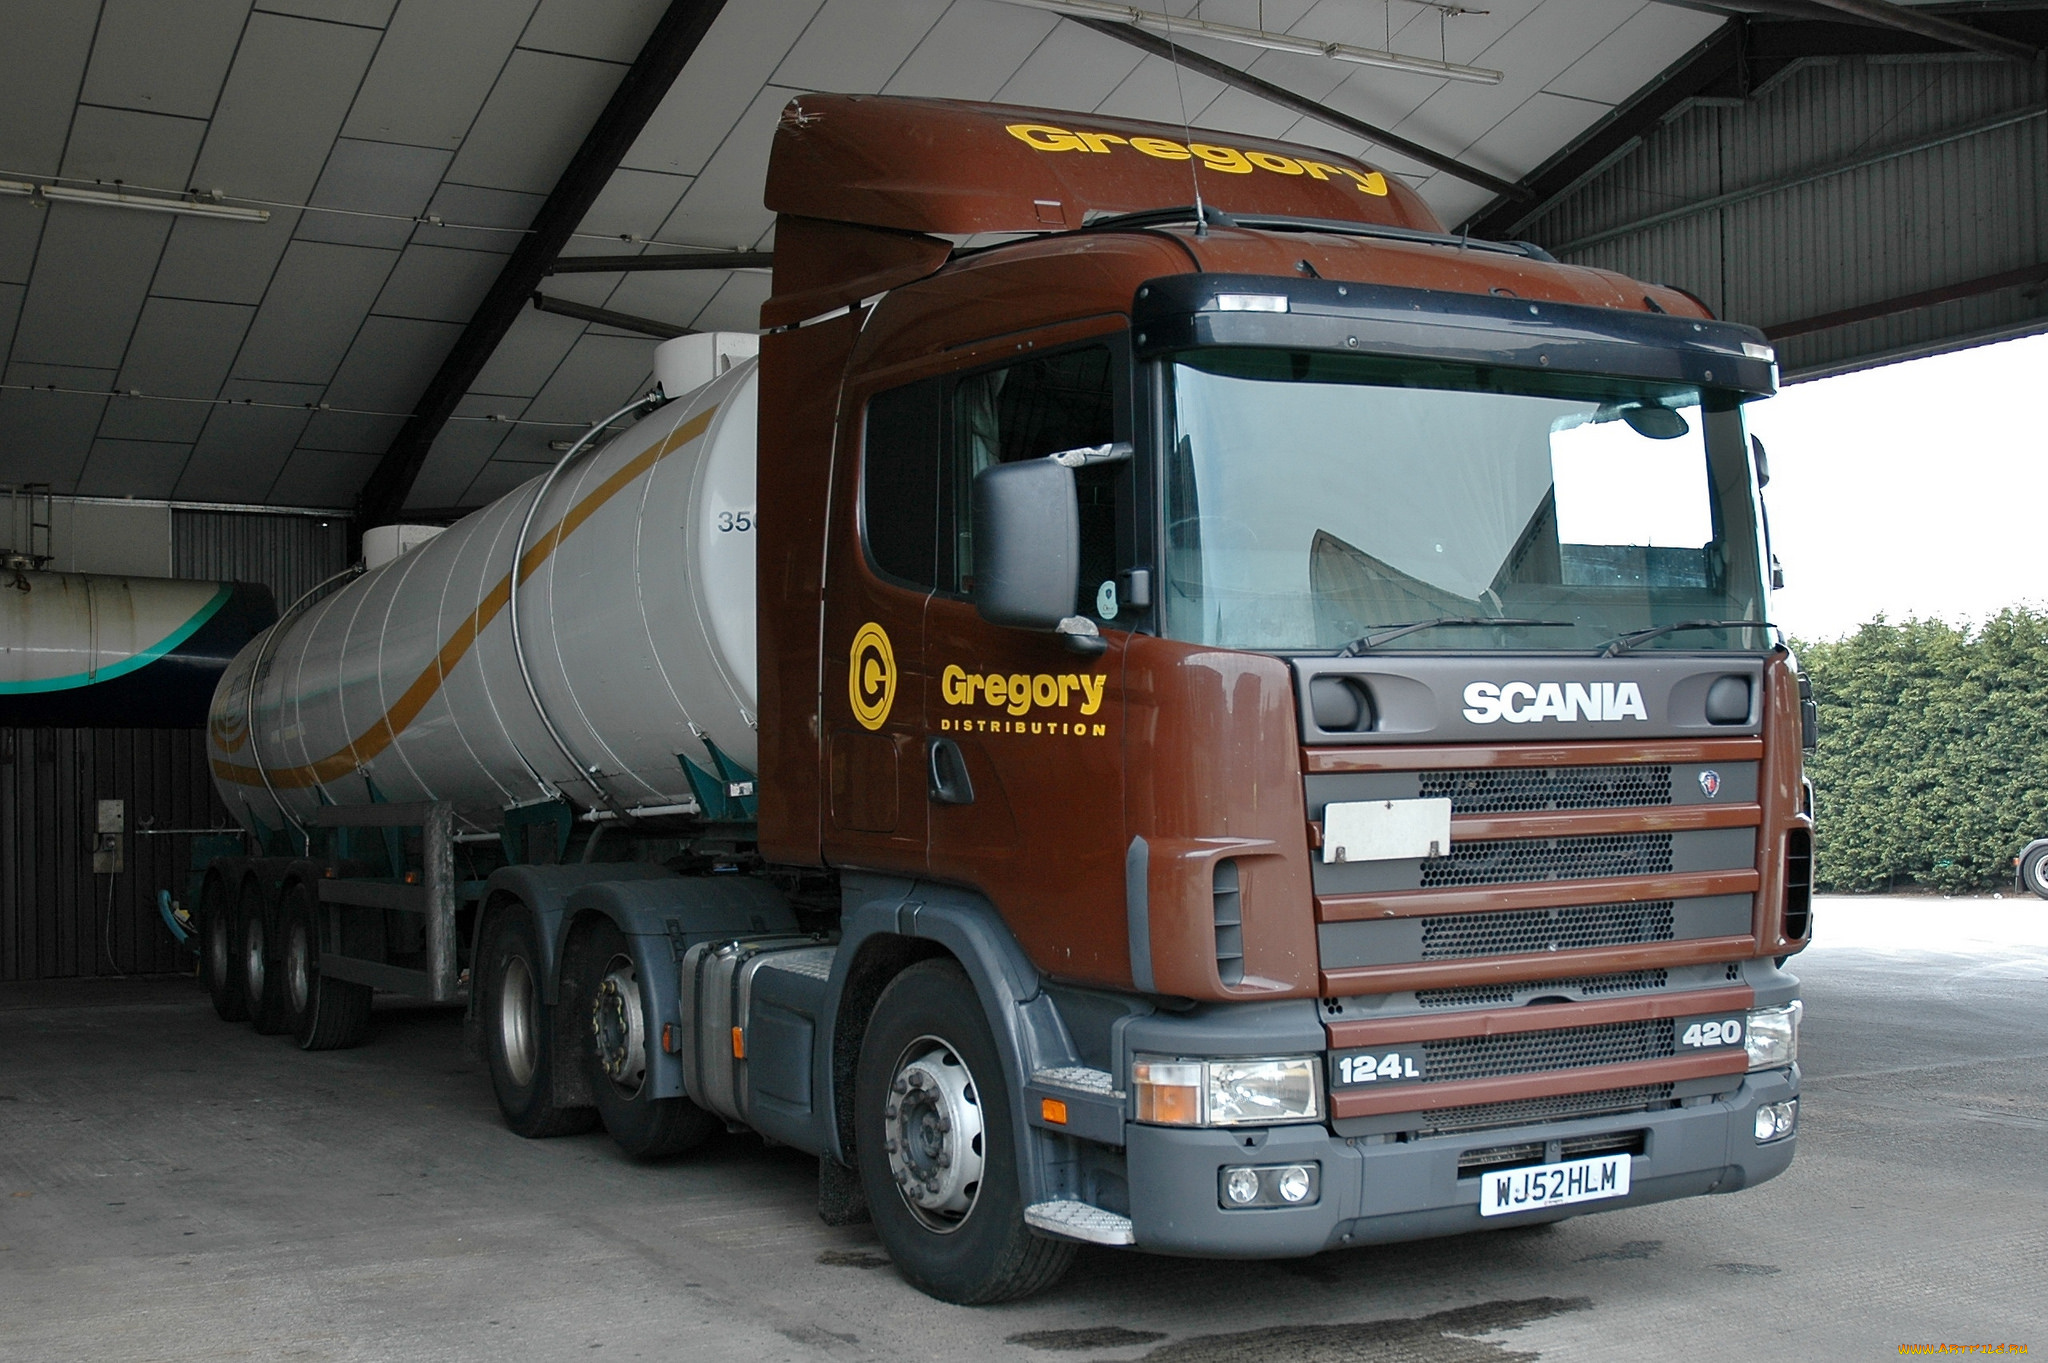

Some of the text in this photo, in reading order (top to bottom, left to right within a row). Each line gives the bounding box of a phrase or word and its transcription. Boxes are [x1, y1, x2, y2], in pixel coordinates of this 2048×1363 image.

[1006, 124, 1388, 196] Gregory
[718, 511, 756, 532] 35
[942, 664, 1107, 716] Gregory
[1463, 682, 1648, 723] SCANIA
[941, 719, 1106, 736] DISTRIBUTION
[1682, 1020, 1742, 1047] 420
